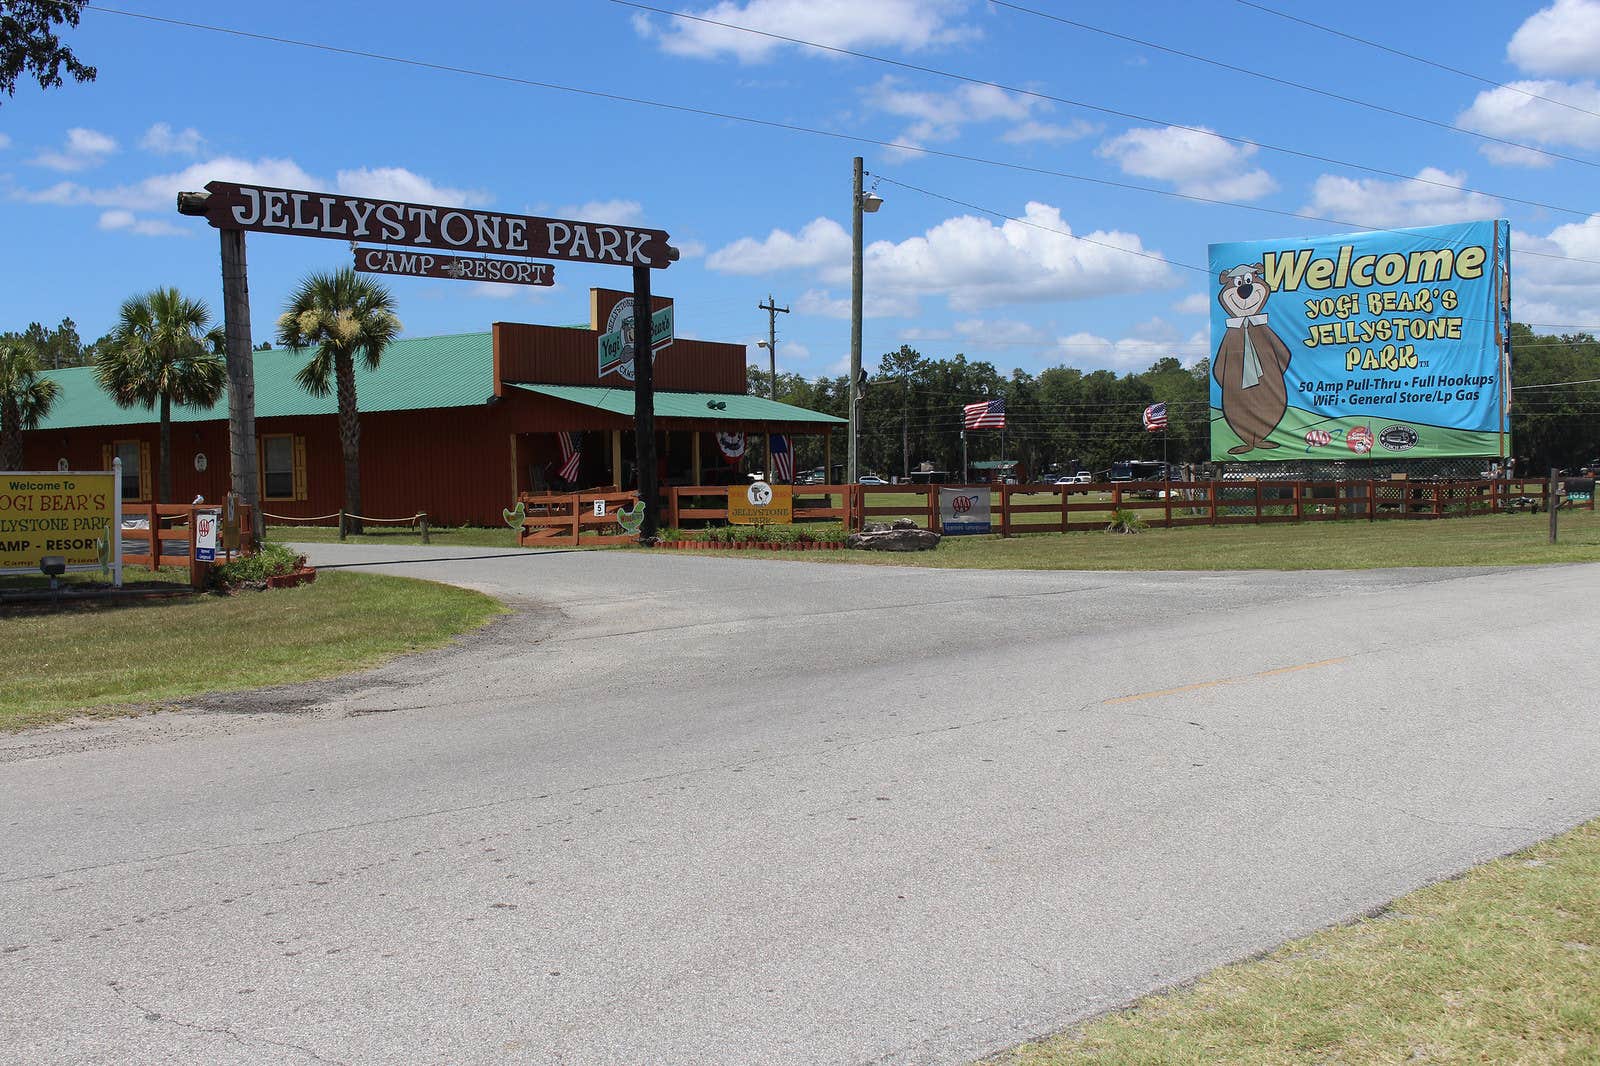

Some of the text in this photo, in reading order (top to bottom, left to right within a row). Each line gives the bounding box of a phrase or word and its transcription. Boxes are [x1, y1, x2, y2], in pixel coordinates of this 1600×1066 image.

[231, 187, 652, 264] JELLYSTONE PARK
[365, 251, 435, 275] CAMP
[458, 258, 546, 284] RESORT
[1263, 245, 1487, 293] Welcome
[1367, 287, 1459, 316] BEAR'S
[1303, 316, 1463, 347] JELLYSTONE
[602, 338, 620, 357] Yogi
[1345, 344, 1418, 371] PARK
[1299, 373, 1494, 394] 50 Amp Pull-Thru Full Hookups
[1313, 389, 1480, 407] WiFi General Store/Lp Gas
[9, 481, 76, 490] Welcome To
[40, 494, 106, 511] BEAR'S
[734, 508, 789, 516] JELLYSTONE
[73, 517, 111, 530] PARK
